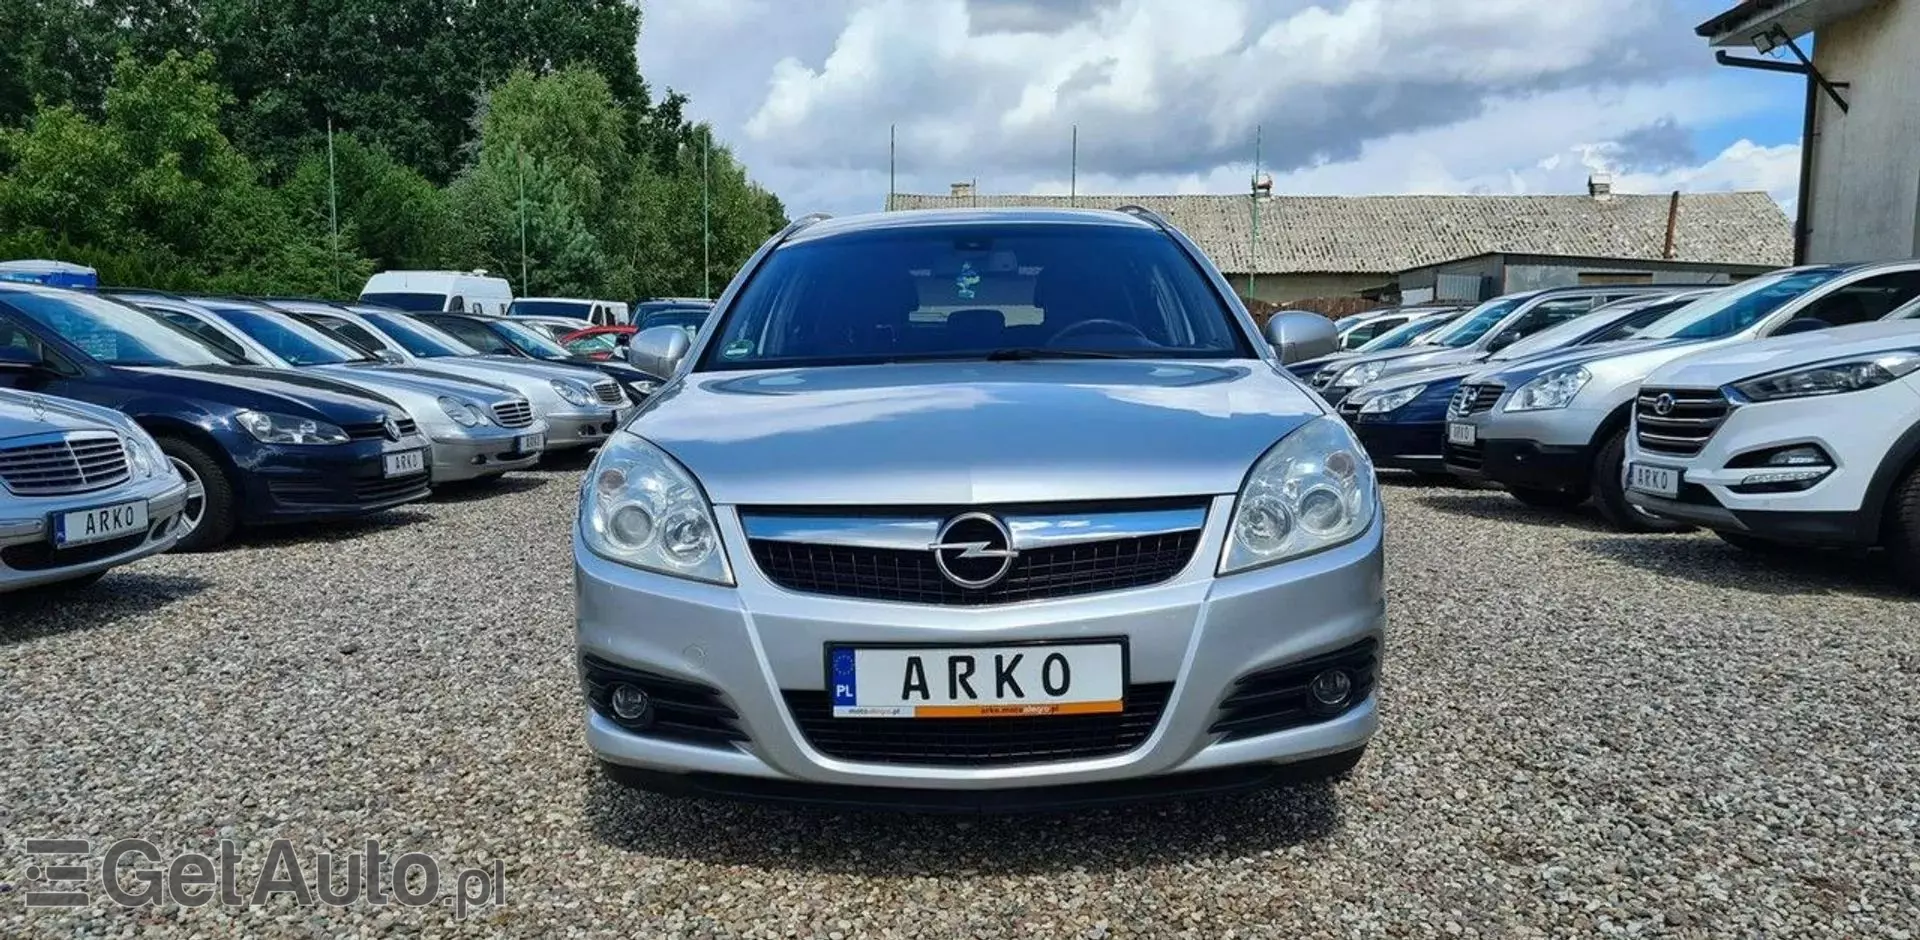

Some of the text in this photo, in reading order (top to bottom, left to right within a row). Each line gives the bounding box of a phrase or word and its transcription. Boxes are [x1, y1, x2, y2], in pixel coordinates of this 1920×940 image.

[1638, 468, 1668, 490] ARKO
[86, 506, 134, 535] ARKO
[902, 652, 1071, 700] ARKO
[836, 684, 853, 698] PL
